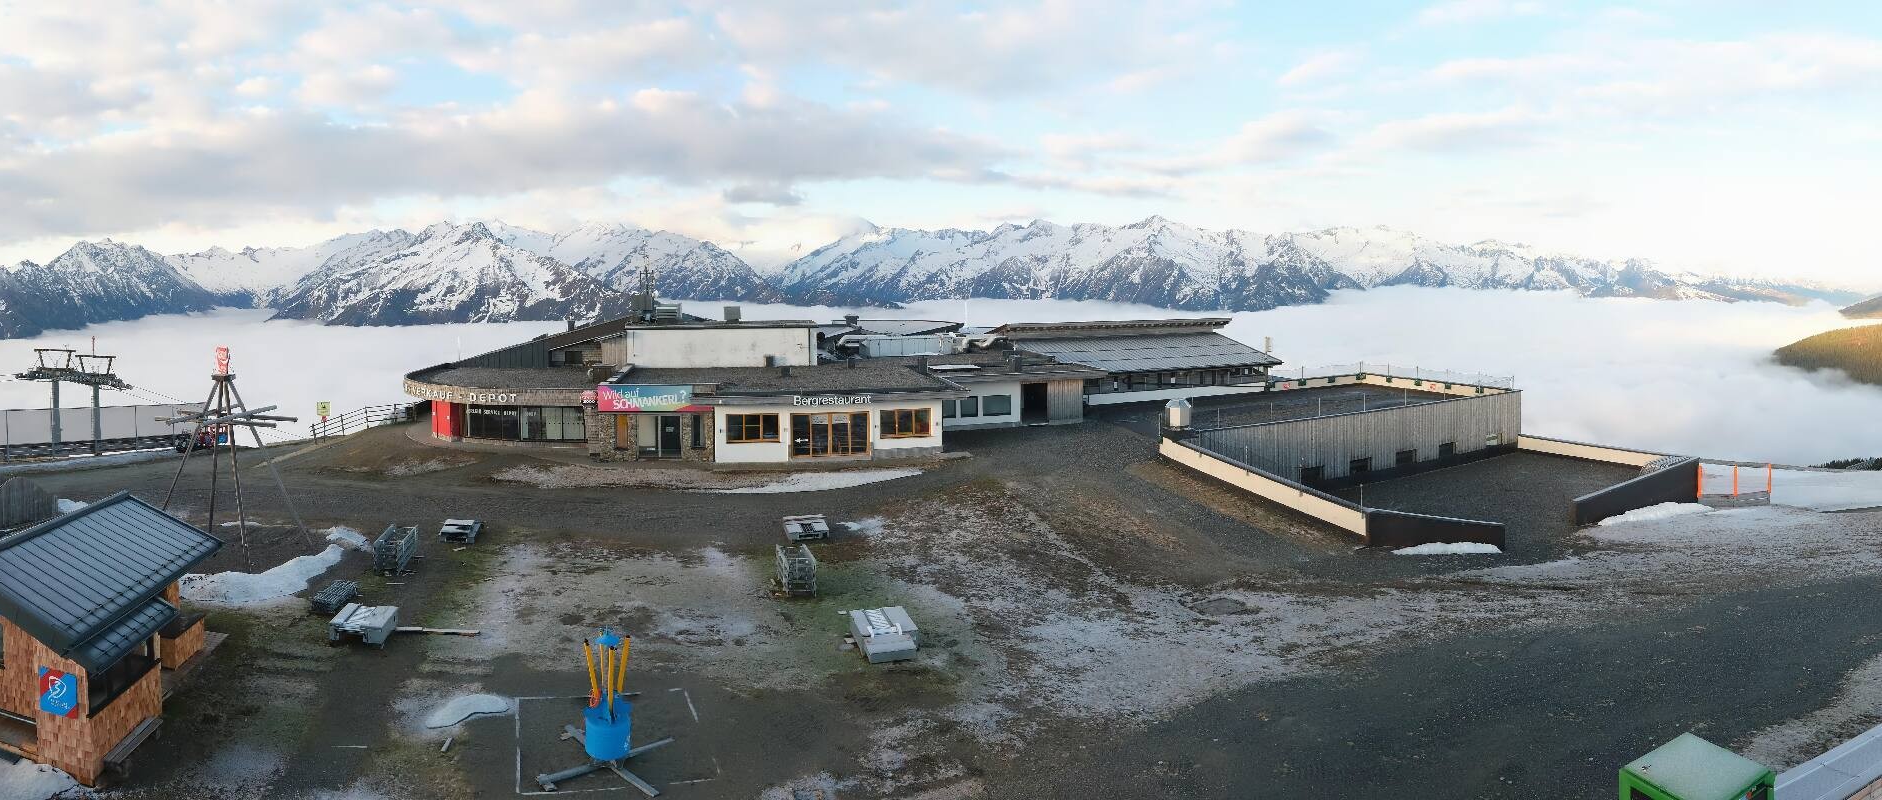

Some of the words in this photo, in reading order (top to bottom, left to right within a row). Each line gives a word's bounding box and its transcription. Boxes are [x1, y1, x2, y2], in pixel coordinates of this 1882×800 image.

[469, 393, 517, 402] DEPOT
[603, 390, 623, 400] Wild
[625, 388, 640, 398] auf
[793, 395, 872, 407] Bergrestaurant
